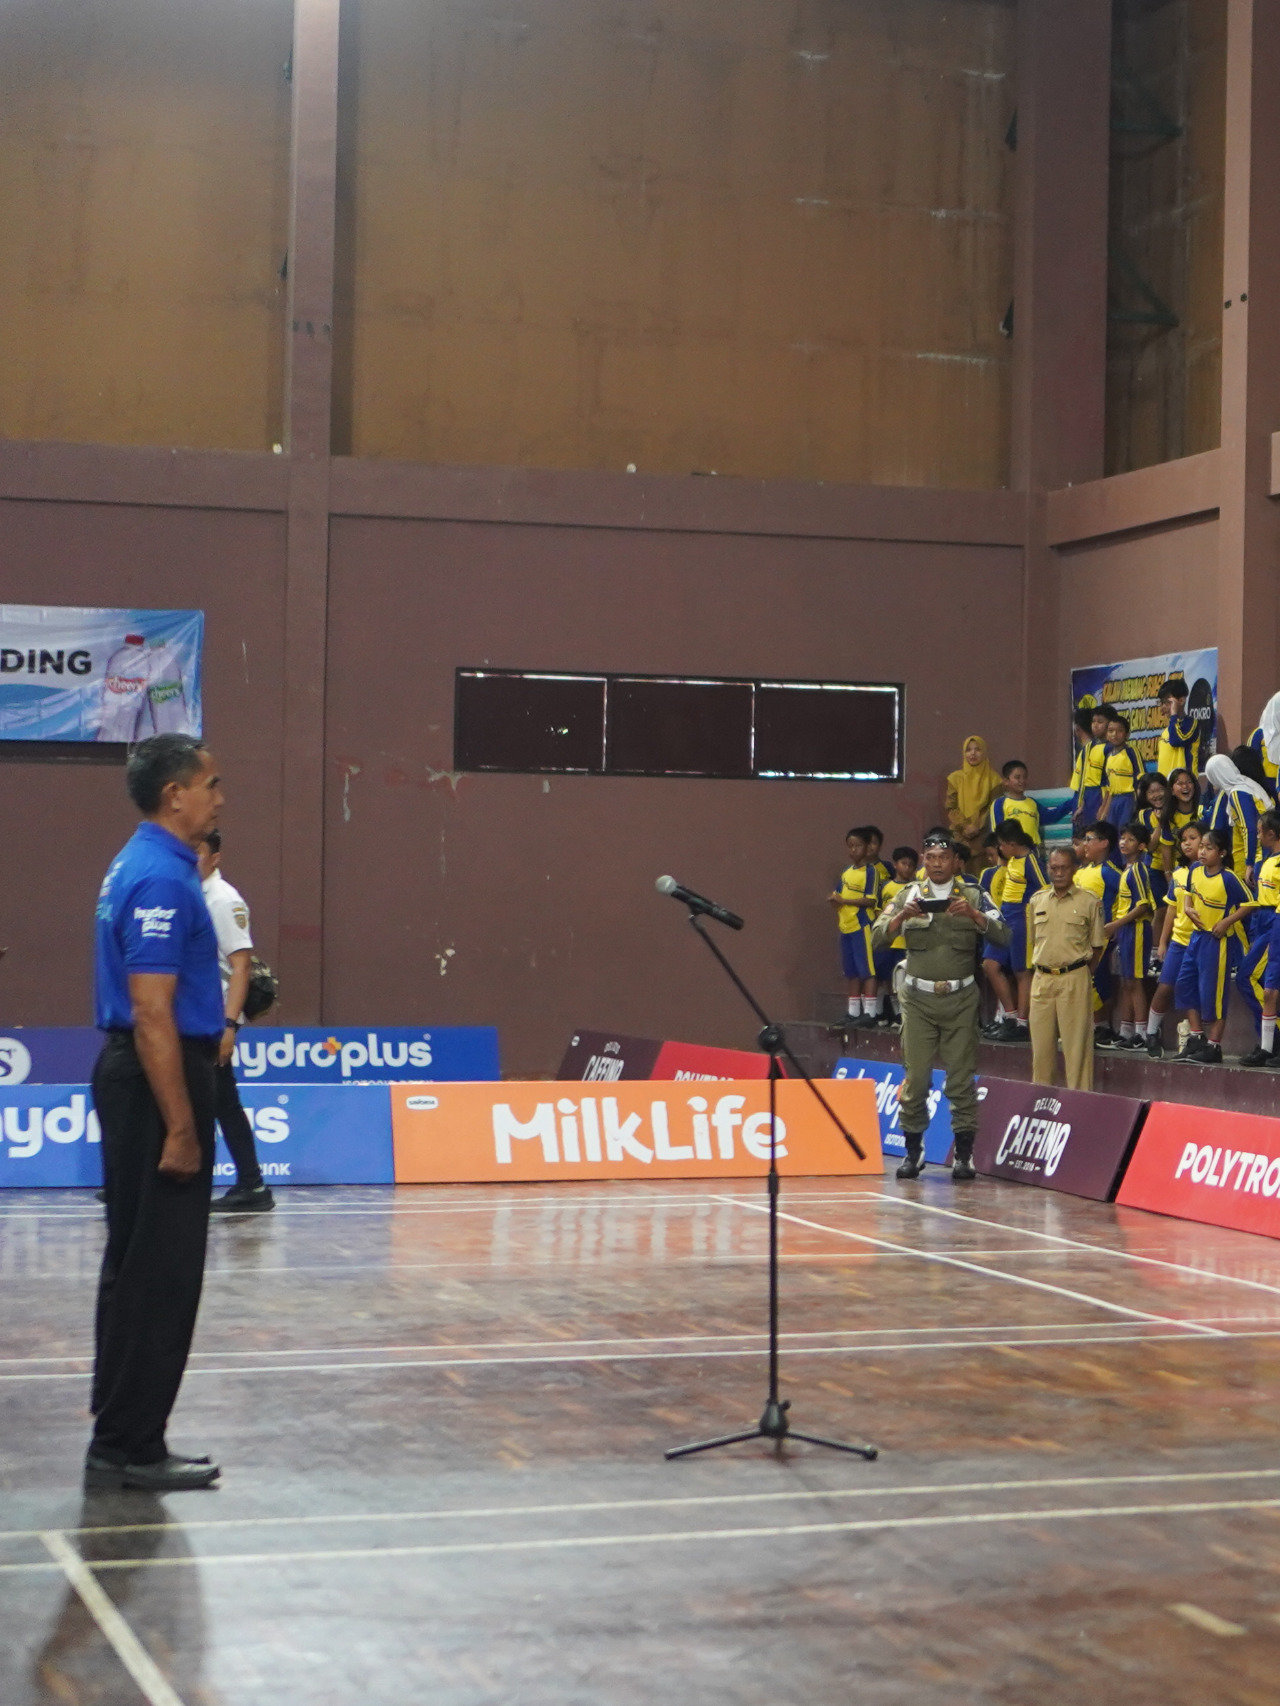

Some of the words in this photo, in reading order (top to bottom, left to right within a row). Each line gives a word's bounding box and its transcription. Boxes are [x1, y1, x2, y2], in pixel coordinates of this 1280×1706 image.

[0, 649, 92, 675] DING
[1033, 1097, 1062, 1116] DELIZIO
[492, 1094, 788, 1164] MilkLife
[995, 1114, 1072, 1177] CAFFINO
